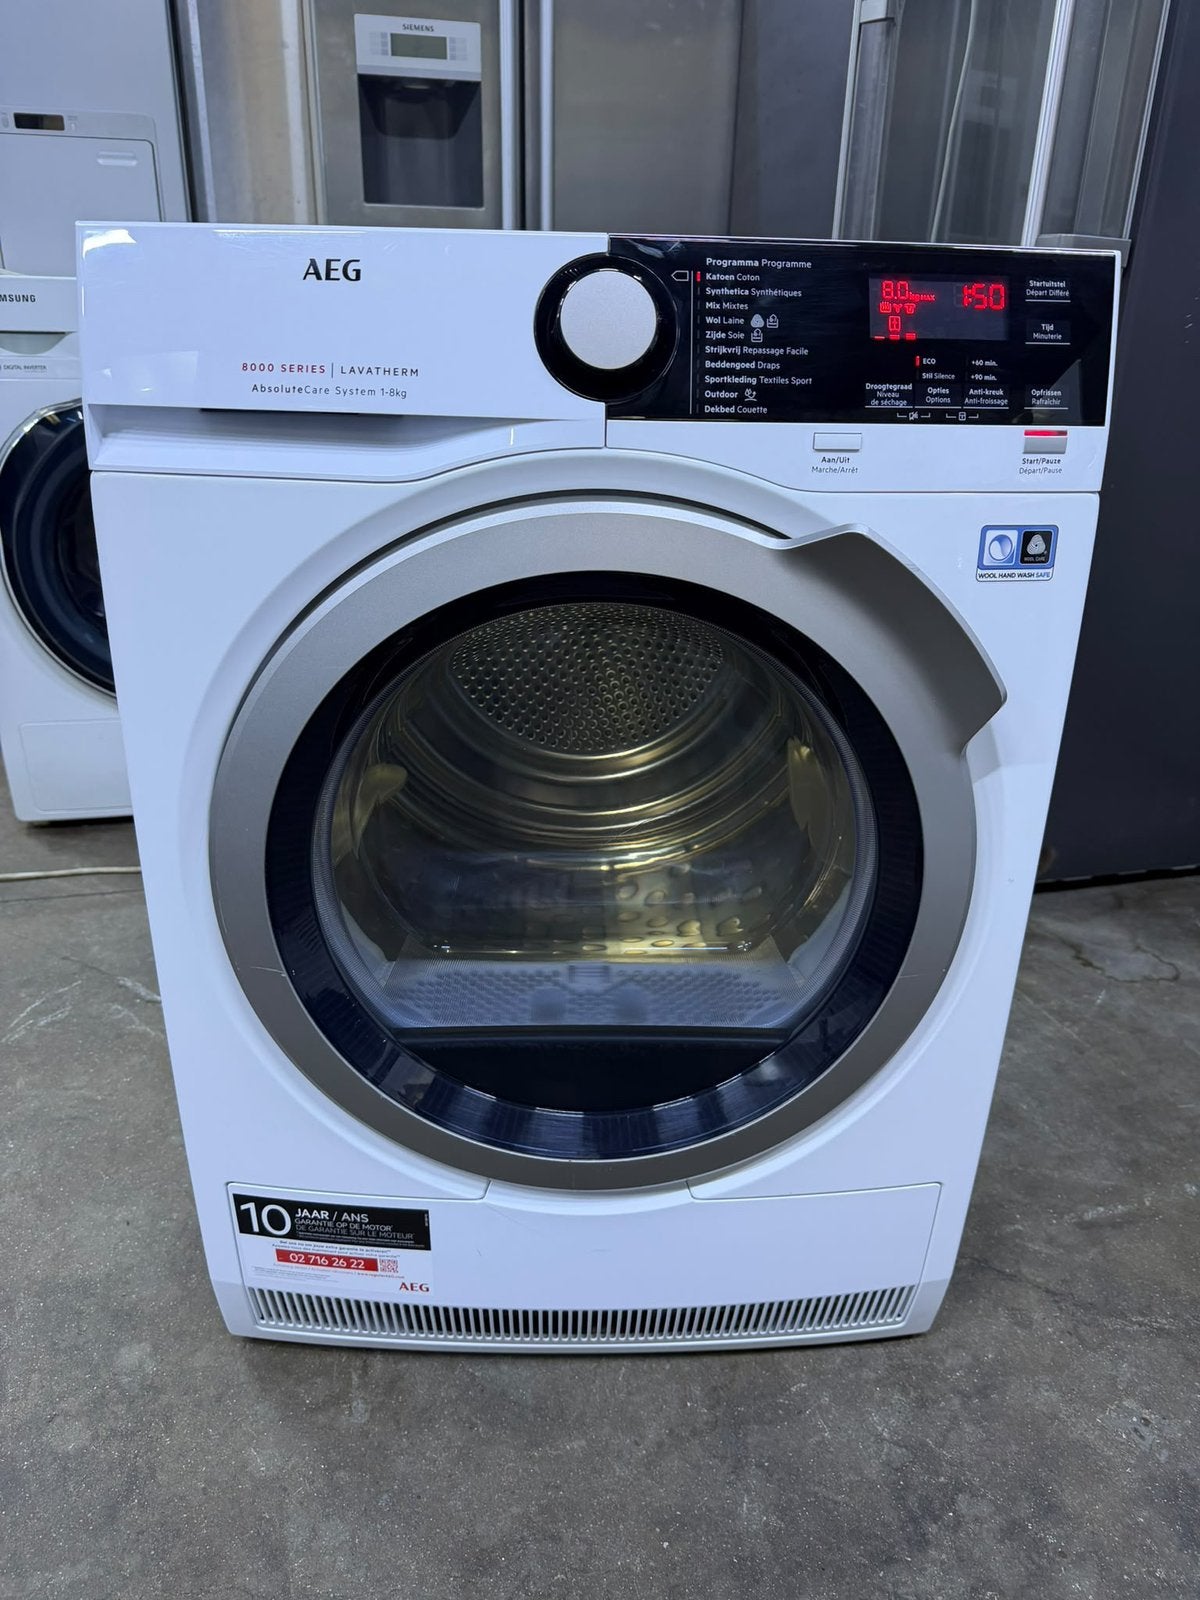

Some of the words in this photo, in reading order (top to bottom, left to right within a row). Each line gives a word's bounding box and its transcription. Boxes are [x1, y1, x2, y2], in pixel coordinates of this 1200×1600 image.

[402, 23, 434, 32] SIEMENS
[706, 258, 759, 268] Programma
[761, 259, 812, 269] Programme
[302, 258, 361, 282] AEG
[706, 272, 734, 280] Katoen
[736, 273, 760, 281] Coton
[1029, 280, 1066, 288] Startuitstel
[706, 287, 749, 296] Synthetica
[751, 288, 802, 298] Synthétiques
[962, 283, 1005, 310] 1:50
[1026, 288, 1048, 296] Départ
[706, 302, 720, 310] Mix
[722, 302, 748, 310] Mixtes
[706, 316, 720, 324] Wol
[723, 316, 744, 324] Laine
[1040, 324, 1054, 332] Tijd
[706, 330, 726, 340] Zijde
[728, 331, 745, 339] Soie
[1032, 332, 1062, 340] Minuterie
[705, 346, 741, 355] Strijkvrij
[742, 346, 784, 356] Repassage
[786, 347, 809, 356] Facile
[242, 362, 274, 372] 8000
[280, 364, 326, 374] SERIES
[340, 366, 419, 377] LAVATHERM
[705, 360, 756, 370] Beddengoed
[757, 361, 780, 370] Draps
[704, 375, 757, 385] Sportkleding
[759, 376, 789, 385] Textiles
[791, 377, 812, 386] Sport
[865, 382, 912, 391] Droogtegraad
[927, 386, 950, 394] Opties
[252, 384, 330, 395] AbsoluteCare
[335, 386, 376, 397] System
[381, 388, 407, 400] 1-8kg
[704, 390, 738, 398] Outdoor
[969, 388, 1004, 396] Anti-kreuk
[1031, 388, 1062, 396] Opfrissen
[925, 396, 951, 404] Options
[964, 398, 1008, 406] Anti-froissage
[704, 405, 736, 413] Dekbed
[737, 406, 768, 414] Couette
[821, 456, 850, 464] Aan/Uit
[811, 466, 858, 474] Marche/Arrêt
[1019, 467, 1062, 475] Départ/Pause
[240, 1202, 292, 1236] 10
[295, 1208, 330, 1220] JAAR
[340, 1212, 369, 1223] ANS
[294, 1218, 334, 1228] GARANTIE
[336, 1222, 348, 1230] OP
[308, 1225, 348, 1235] GARANTIE
[349, 1229, 366, 1237] SUR
[290, 1253, 305, 1263] 02
[309, 1255, 329, 1266] 716
[332, 1257, 347, 1267] 26
[350, 1259, 365, 1269] 22
[400, 1282, 430, 1292] AEG
